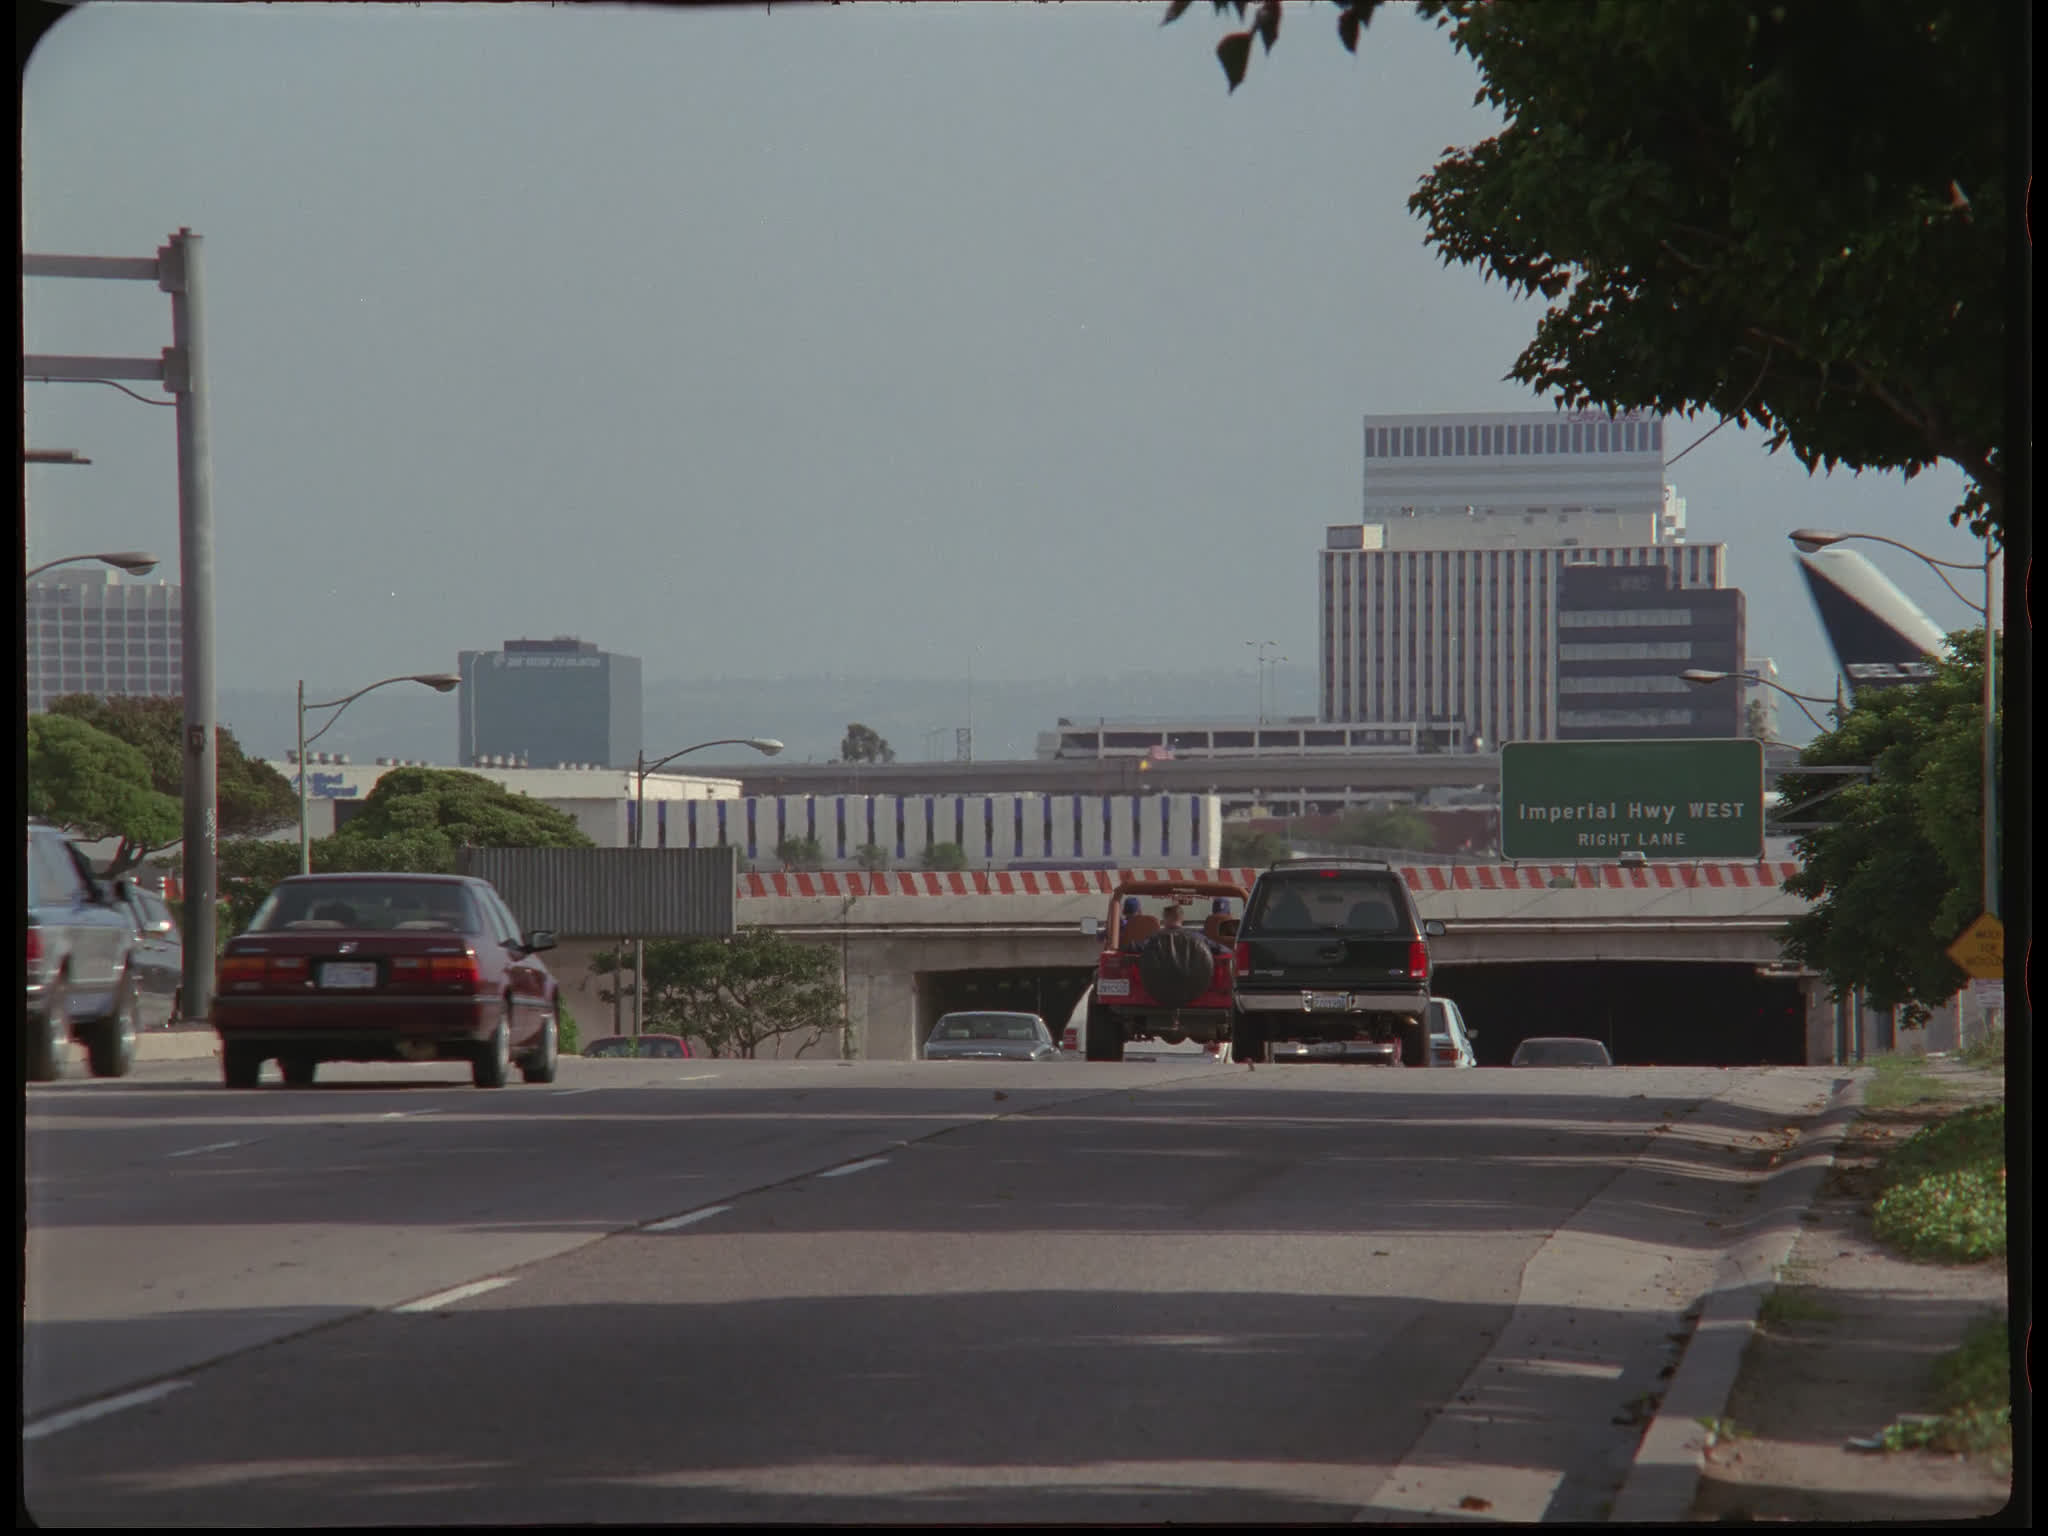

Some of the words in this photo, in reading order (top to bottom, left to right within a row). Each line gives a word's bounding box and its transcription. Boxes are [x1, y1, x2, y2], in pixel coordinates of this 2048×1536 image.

[1519, 802, 1616, 823] Imperial
[1628, 802, 1676, 824] Hwy
[1688, 802, 1744, 818] WEST
[1578, 832, 1631, 846] RIGHT
[1639, 832, 1686, 845] LANE
